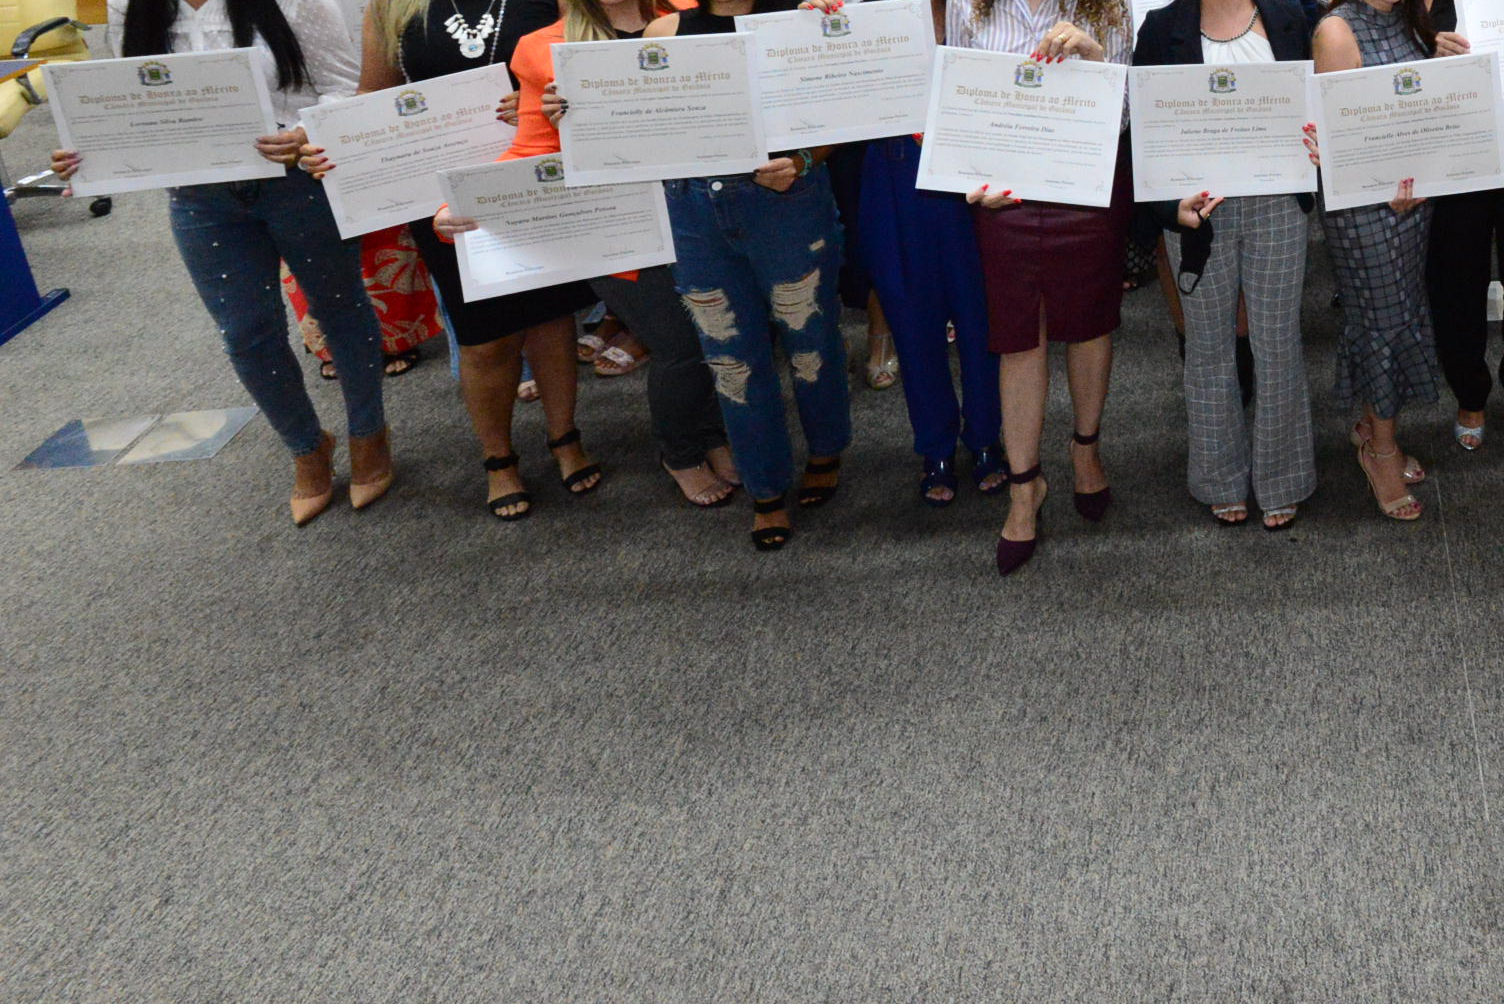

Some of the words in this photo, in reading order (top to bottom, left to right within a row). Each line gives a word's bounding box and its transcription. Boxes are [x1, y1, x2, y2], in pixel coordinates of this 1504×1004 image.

[766, 47, 808, 58] Diploma
[812, 44, 822, 53] de
[826, 42, 858, 51] Honra
[875, 35, 910, 46] Mérito
[581, 79, 625, 89] Diploma
[629, 77, 639, 86] de
[644, 75, 677, 85] Honra
[695, 71, 731, 82] Mérito
[80, 93, 127, 104] Diploma
[131, 91, 143, 100] de
[147, 89, 182, 99] Honra
[201, 84, 240, 95] Mérito
[957, 87, 998, 98] Diploma
[1002, 91, 1012, 100] de
[1015, 92, 1046, 103] Honra
[1063, 97, 1097, 108] Mérito
[1155, 100, 1195, 109] Diploma
[1199, 99, 1208, 107] de
[1212, 98, 1242, 107] Honra
[1259, 96, 1291, 105] Mérito
[1339, 106, 1380, 117] Diploma
[1384, 103, 1394, 111] de
[1397, 99, 1428, 109] Honra
[1445, 91, 1478, 103] Mérito
[340, 129, 385, 145] Diploma
[388, 125, 400, 134] de
[403, 116, 437, 130] Honra
[440, 113, 452, 122] ao
[455, 103, 492, 119] Mérito
[476, 192, 522, 205] Diploma
[527, 189, 538, 198] de
